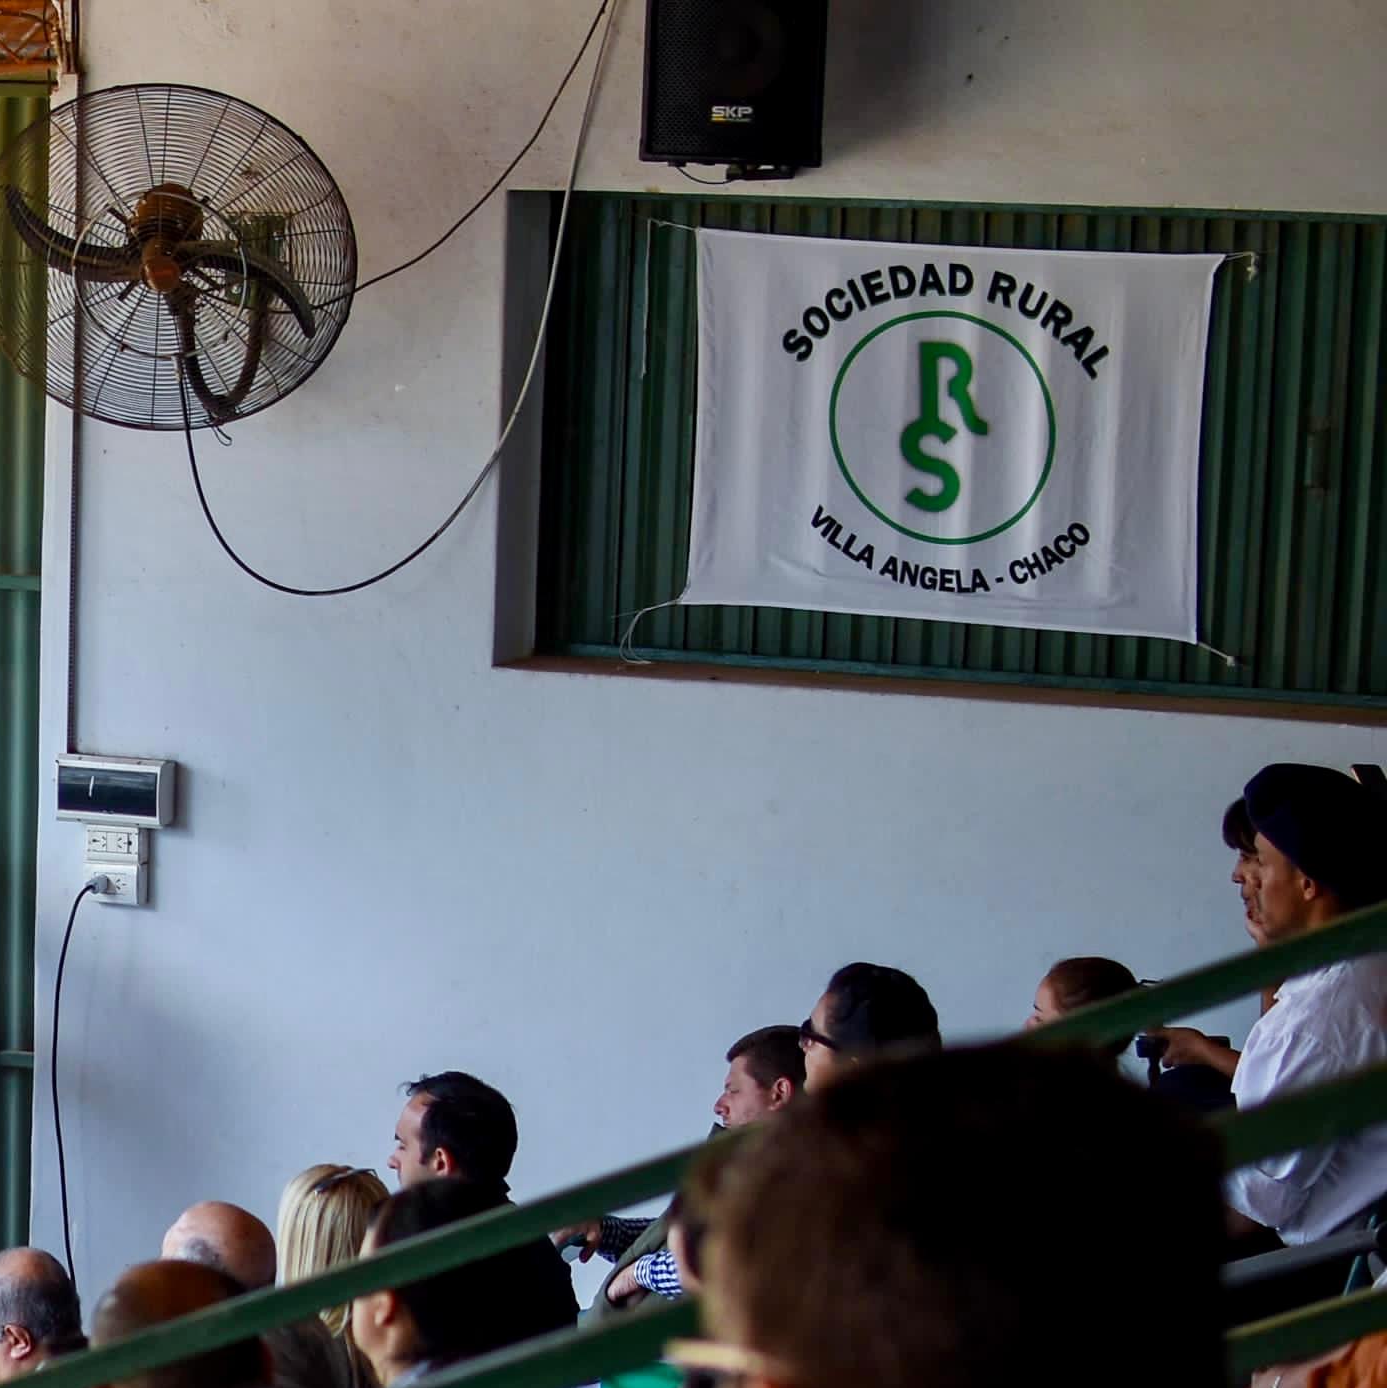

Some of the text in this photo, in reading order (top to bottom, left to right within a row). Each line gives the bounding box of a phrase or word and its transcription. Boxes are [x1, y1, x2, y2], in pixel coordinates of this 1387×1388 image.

[711, 105, 753, 118] SKP
[782, 263, 1110, 380] SOCIEDAD RURAL
[809, 504, 876, 569] VILLA
[879, 555, 990, 594] ANGELA
[1008, 521, 1091, 585] CHACO
